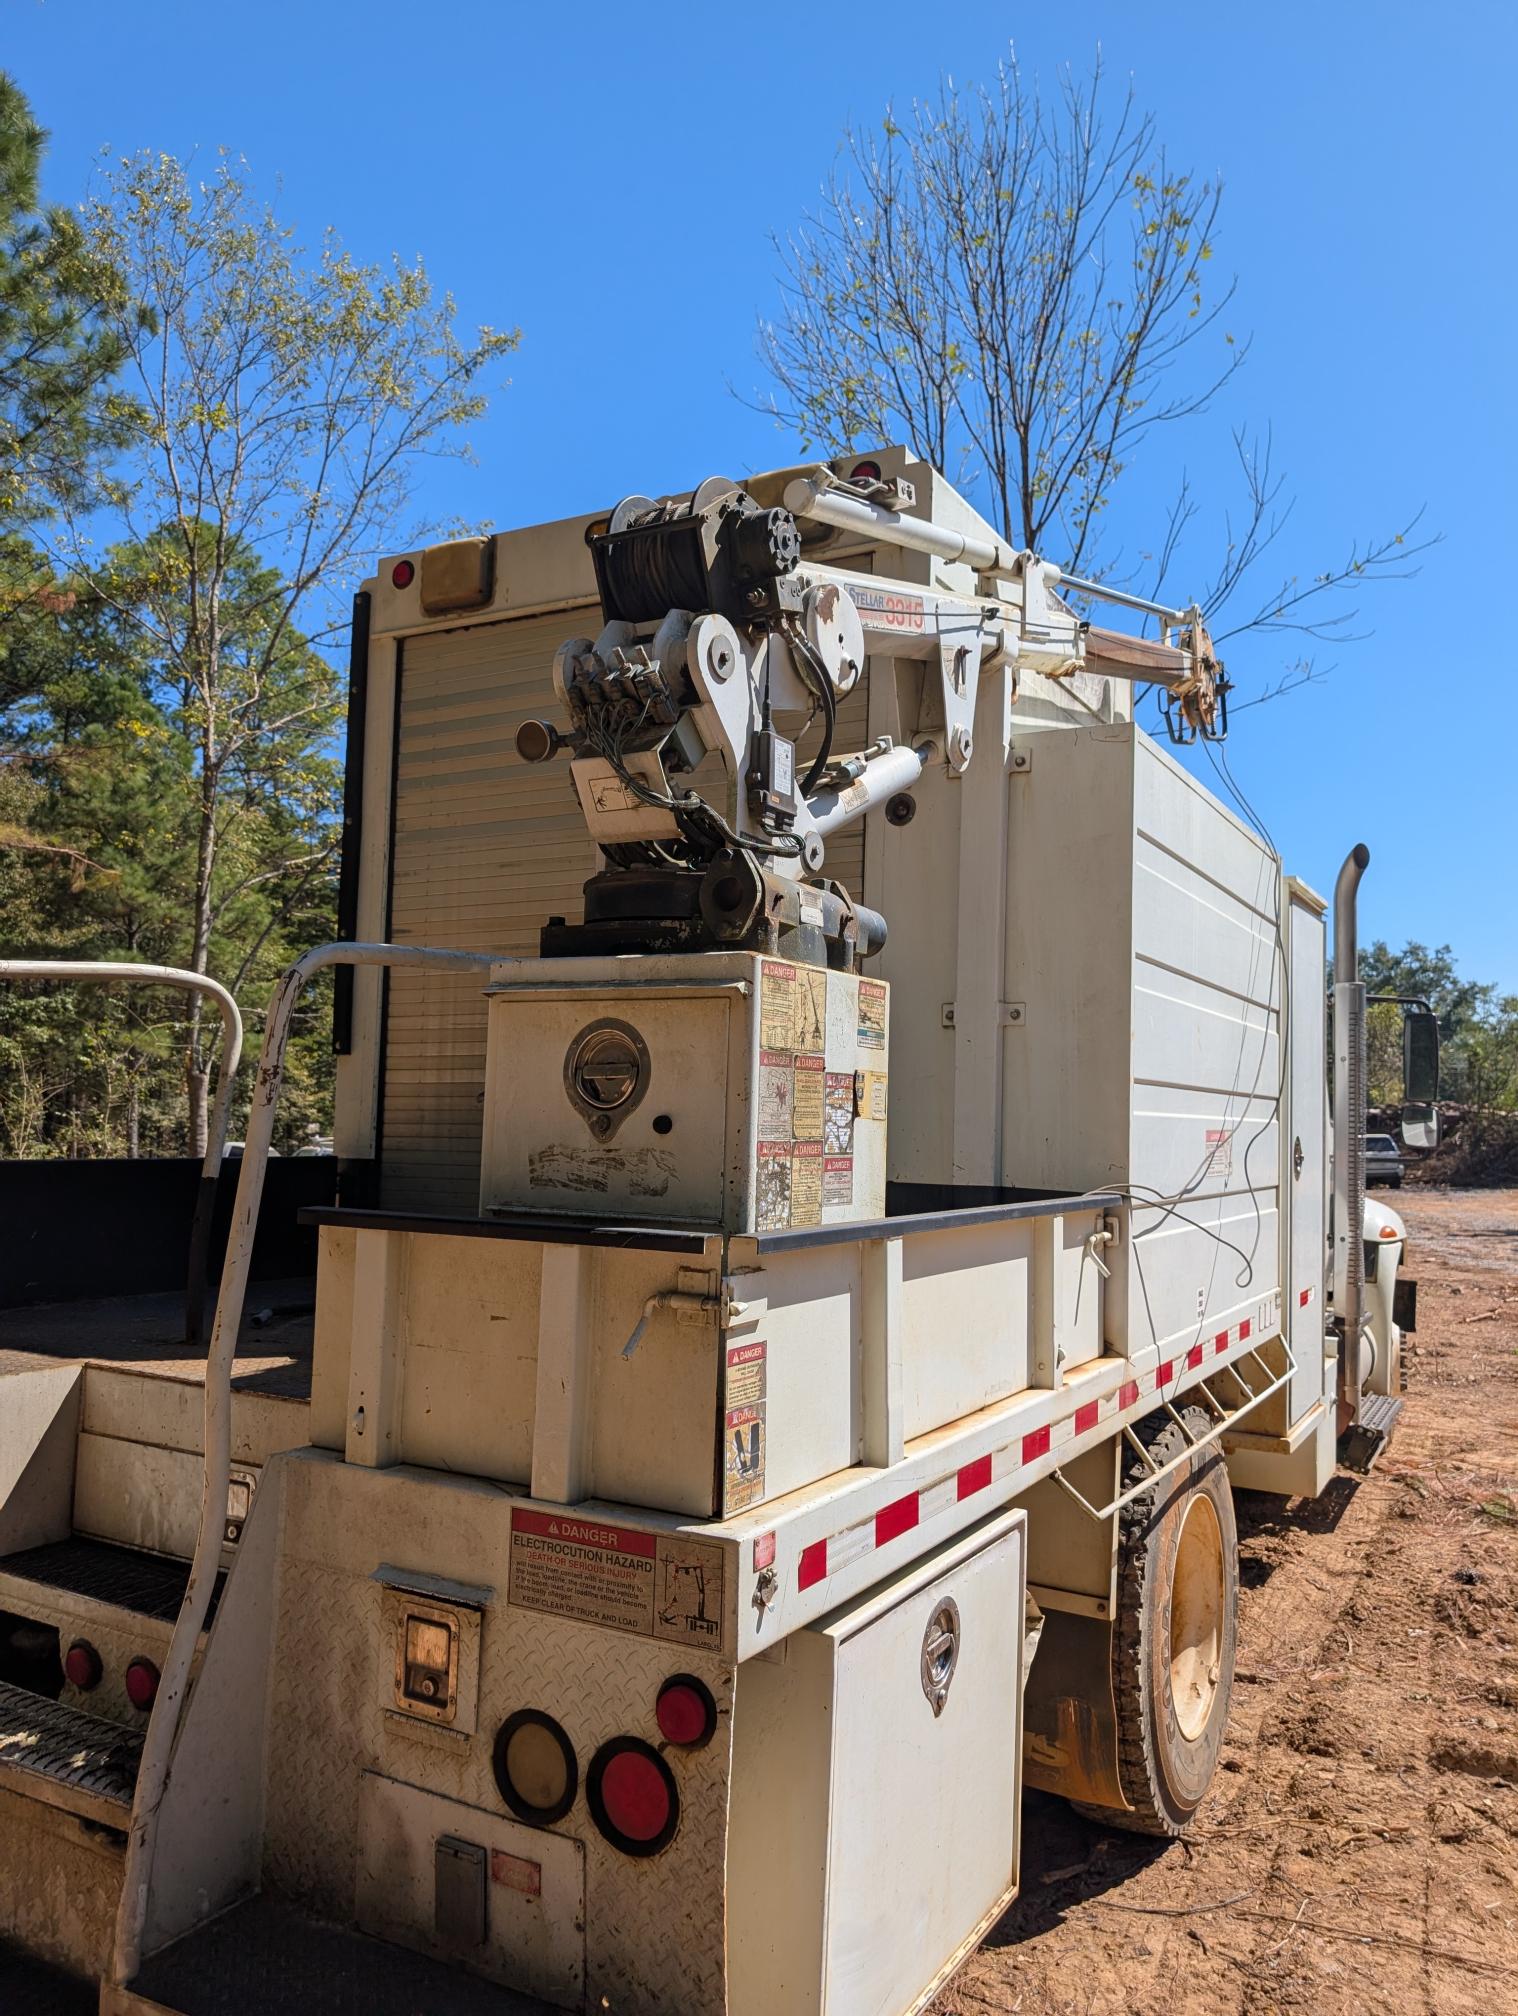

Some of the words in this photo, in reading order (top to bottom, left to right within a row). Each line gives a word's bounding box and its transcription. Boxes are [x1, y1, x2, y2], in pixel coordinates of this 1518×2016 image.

[848, 587, 884, 608] STELLAR
[770, 967, 795, 980] DANGER
[802, 1058, 823, 1068] DANGER
[800, 1145, 821, 1156] DANGER
[832, 1161, 850, 1170] DANGER
[739, 1347, 762, 1360] DANGER
[561, 1523, 618, 1546] DANGER
[514, 1535, 602, 1562] ELECTROCUTION
[606, 1554, 652, 1573] HAZARD
[527, 1551, 553, 1563] DEATH
[554, 1558, 566, 1566] OR
[569, 1560, 604, 1574] SERIOUS
[606, 1568, 637, 1580] INJURY
[516, 1584, 546, 1596] electrically
[560, 1570, 582, 1578] contact
[606, 1580, 635, 1592] proximity
[574, 1588, 598, 1598] loadline
[600, 1594, 620, 1604] should
[622, 1598, 647, 1610] become
[580, 1582, 596, 1590] crane
[617, 1590, 639, 1600] vehicle
[522, 1595, 540, 1604] KEEP
[541, 1599, 564, 1611] CLEAR
[566, 1604, 575, 1614] OF
[576, 1608, 600, 1619] TRUCK
[602, 1614, 616, 1622] AND
[618, 1616, 638, 1627] LOAD
